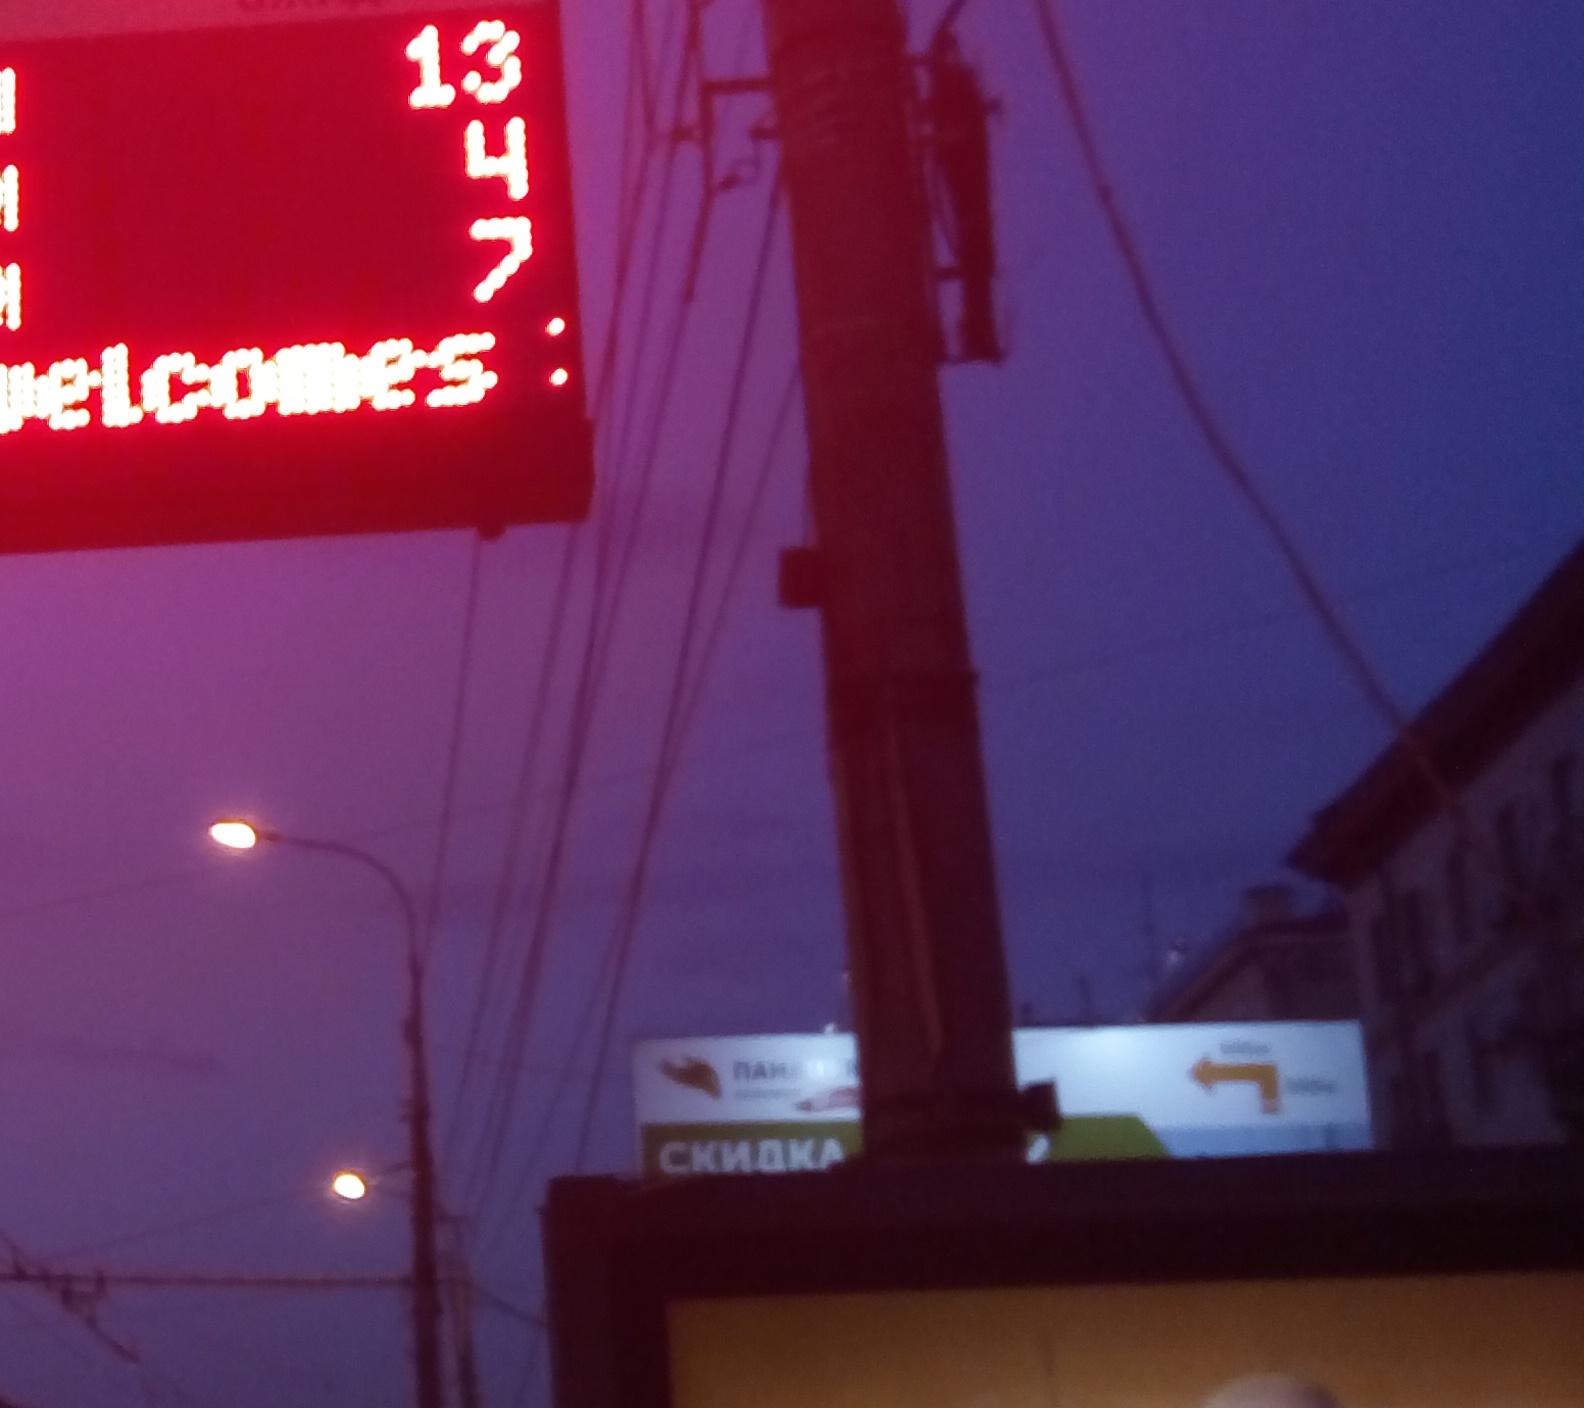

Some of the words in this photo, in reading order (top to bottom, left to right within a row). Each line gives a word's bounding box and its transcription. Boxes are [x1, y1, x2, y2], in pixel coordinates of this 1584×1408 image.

[405, 19, 522, 109] 13
[465, 116, 529, 201] 4
[470, 215, 533, 303] 7
[659, 1137, 844, 1175] СКИДКА
